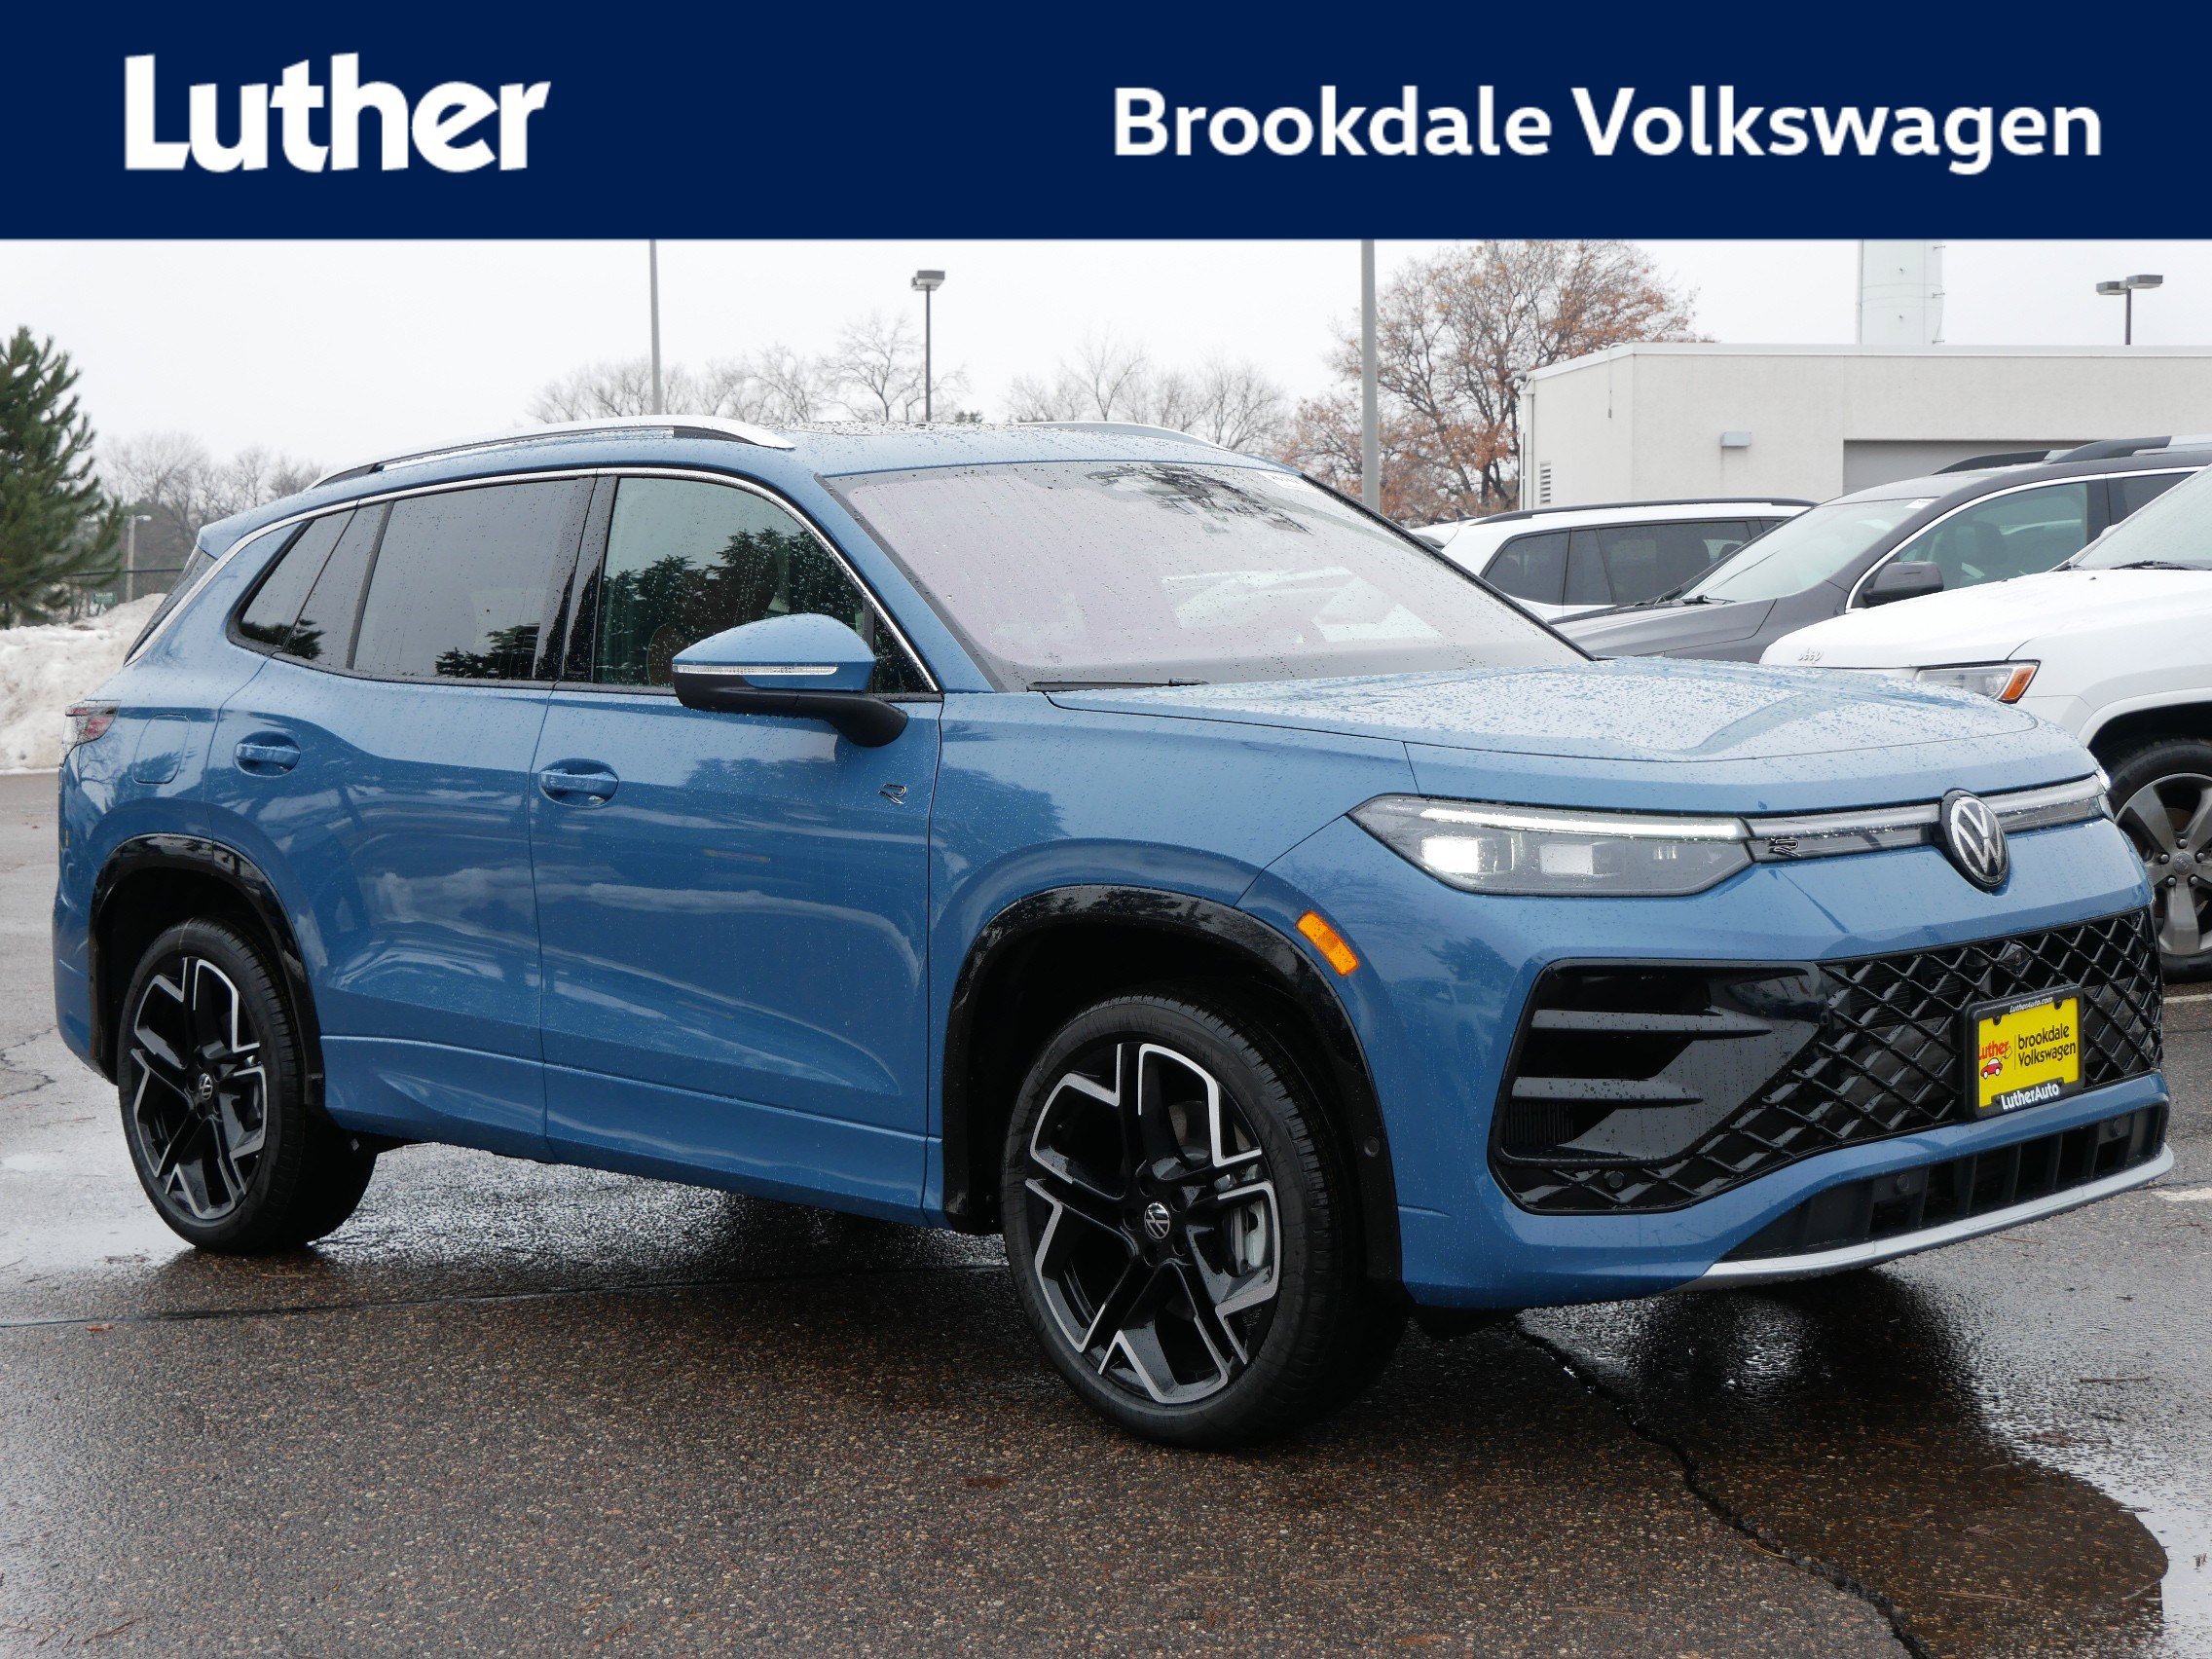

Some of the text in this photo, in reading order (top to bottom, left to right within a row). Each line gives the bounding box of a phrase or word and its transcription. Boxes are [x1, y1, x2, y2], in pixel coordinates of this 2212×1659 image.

[2009, 996, 2053, 1014] LutherAuto.com
[2017, 1022, 2070, 1050] brookdale
[2017, 1042, 2076, 1068] Volkswagen
[2000, 1082, 2060, 1110] LutherAuto
